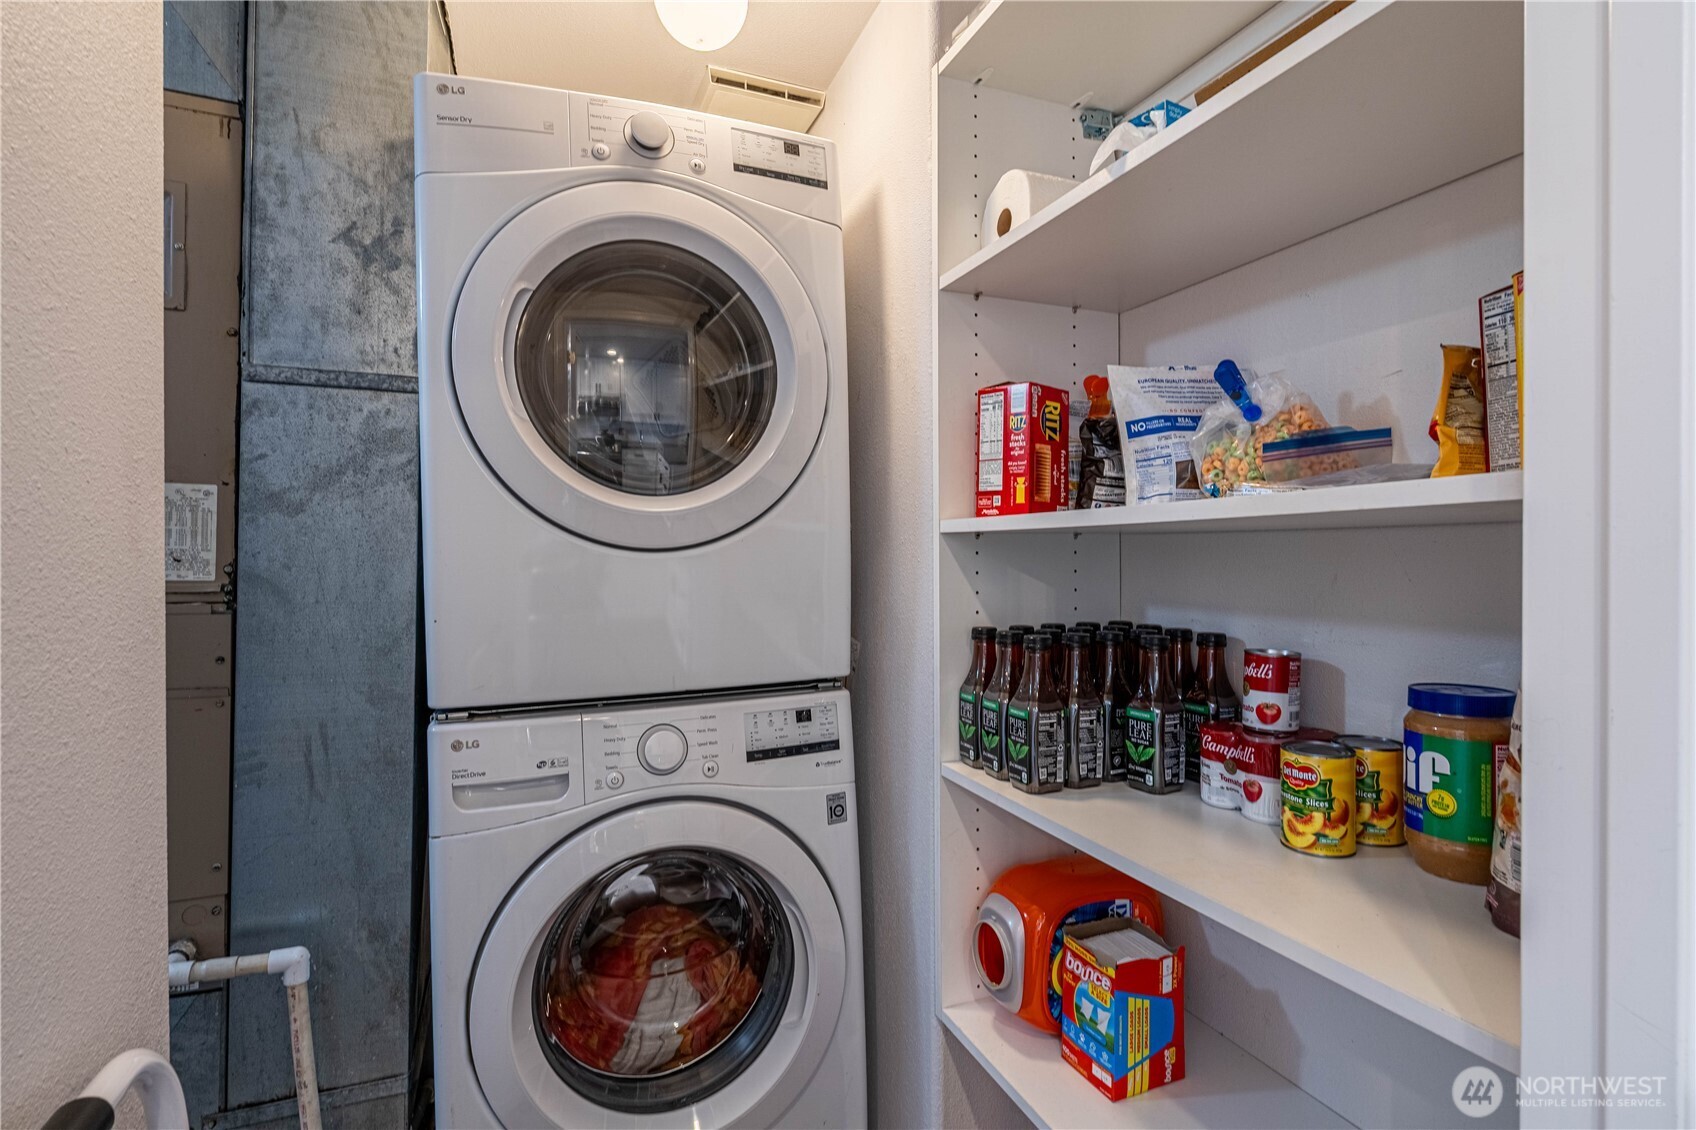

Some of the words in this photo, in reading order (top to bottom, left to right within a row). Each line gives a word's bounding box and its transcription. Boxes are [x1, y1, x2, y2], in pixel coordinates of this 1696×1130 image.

[451, 86, 466, 95] LG
[437, 114, 459, 122] Sensor
[1010, 414, 1027, 430] RITZ
[1045, 399, 1061, 443] RITZ
[1130, 421, 1146, 433] NO
[961, 700, 974, 711] PURE
[983, 709, 998, 719] PURE
[983, 717, 998, 729] LEAF
[1010, 716, 1027, 730] PURE
[1128, 718, 1153, 732] PURE
[1010, 725, 1027, 739] LEAF
[1128, 727, 1152, 741] LEAF
[465, 739, 480, 749] LG
[1202, 734, 1256, 764] Campbell's
[1283, 765, 1291, 776] Del
[1291, 768, 1317, 782] Monte
[1403, 744, 1451, 794] if
[1219, 772, 1243, 788] Tomato
[1356, 789, 1377, 799] lices
[1305, 797, 1329, 808] Slices
[829, 803, 845, 820] 10
[1065, 948, 1112, 992] bounce
[1164, 1049, 1173, 1083] bounce
